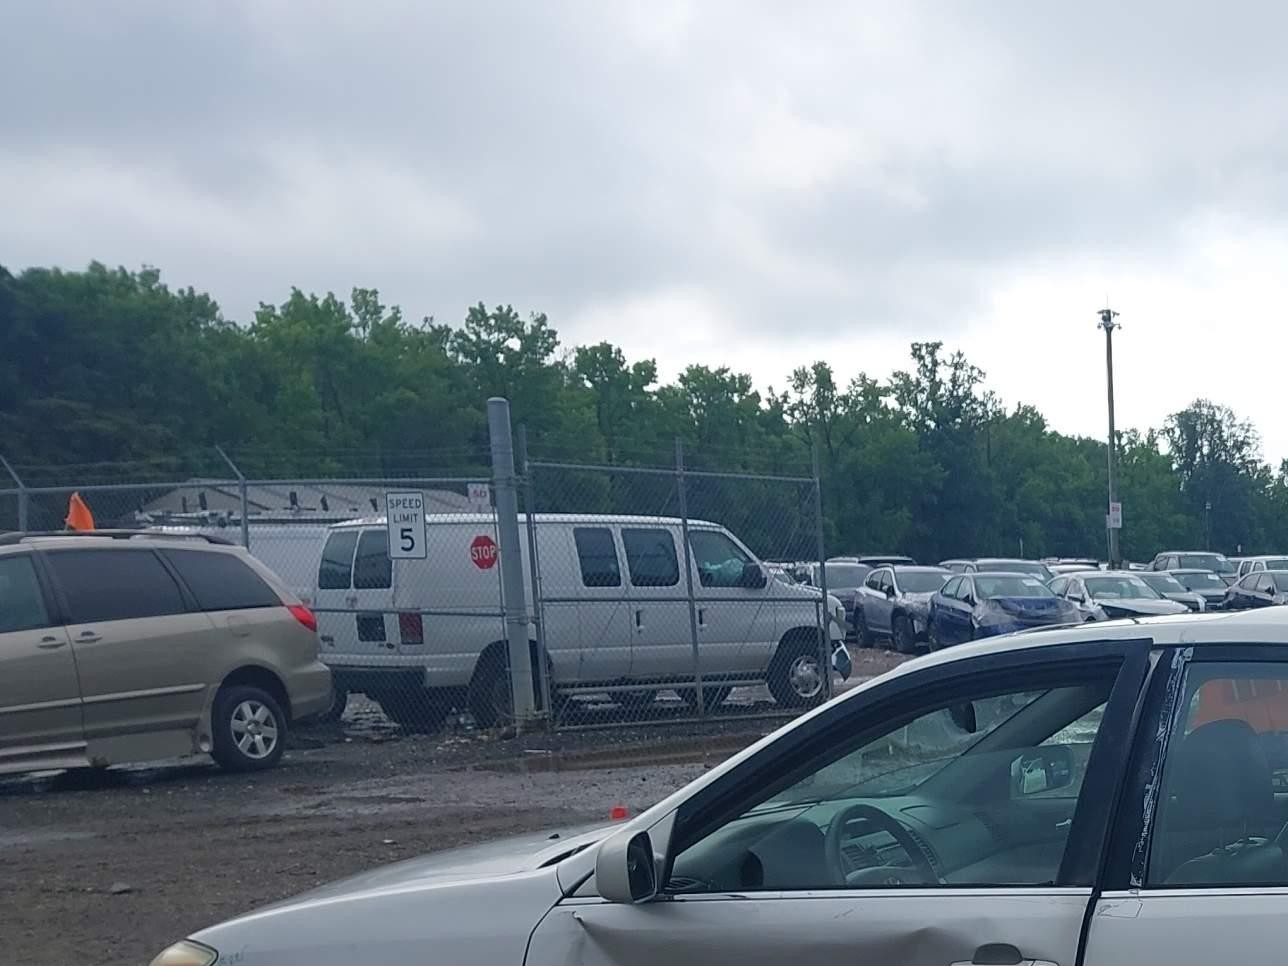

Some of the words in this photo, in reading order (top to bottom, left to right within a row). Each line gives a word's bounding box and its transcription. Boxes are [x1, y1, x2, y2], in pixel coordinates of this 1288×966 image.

[389, 498, 421, 509] SPEED
[393, 513, 418, 523] LIMIT
[401, 528, 415, 552] 5
[471, 546, 496, 560] STOP
